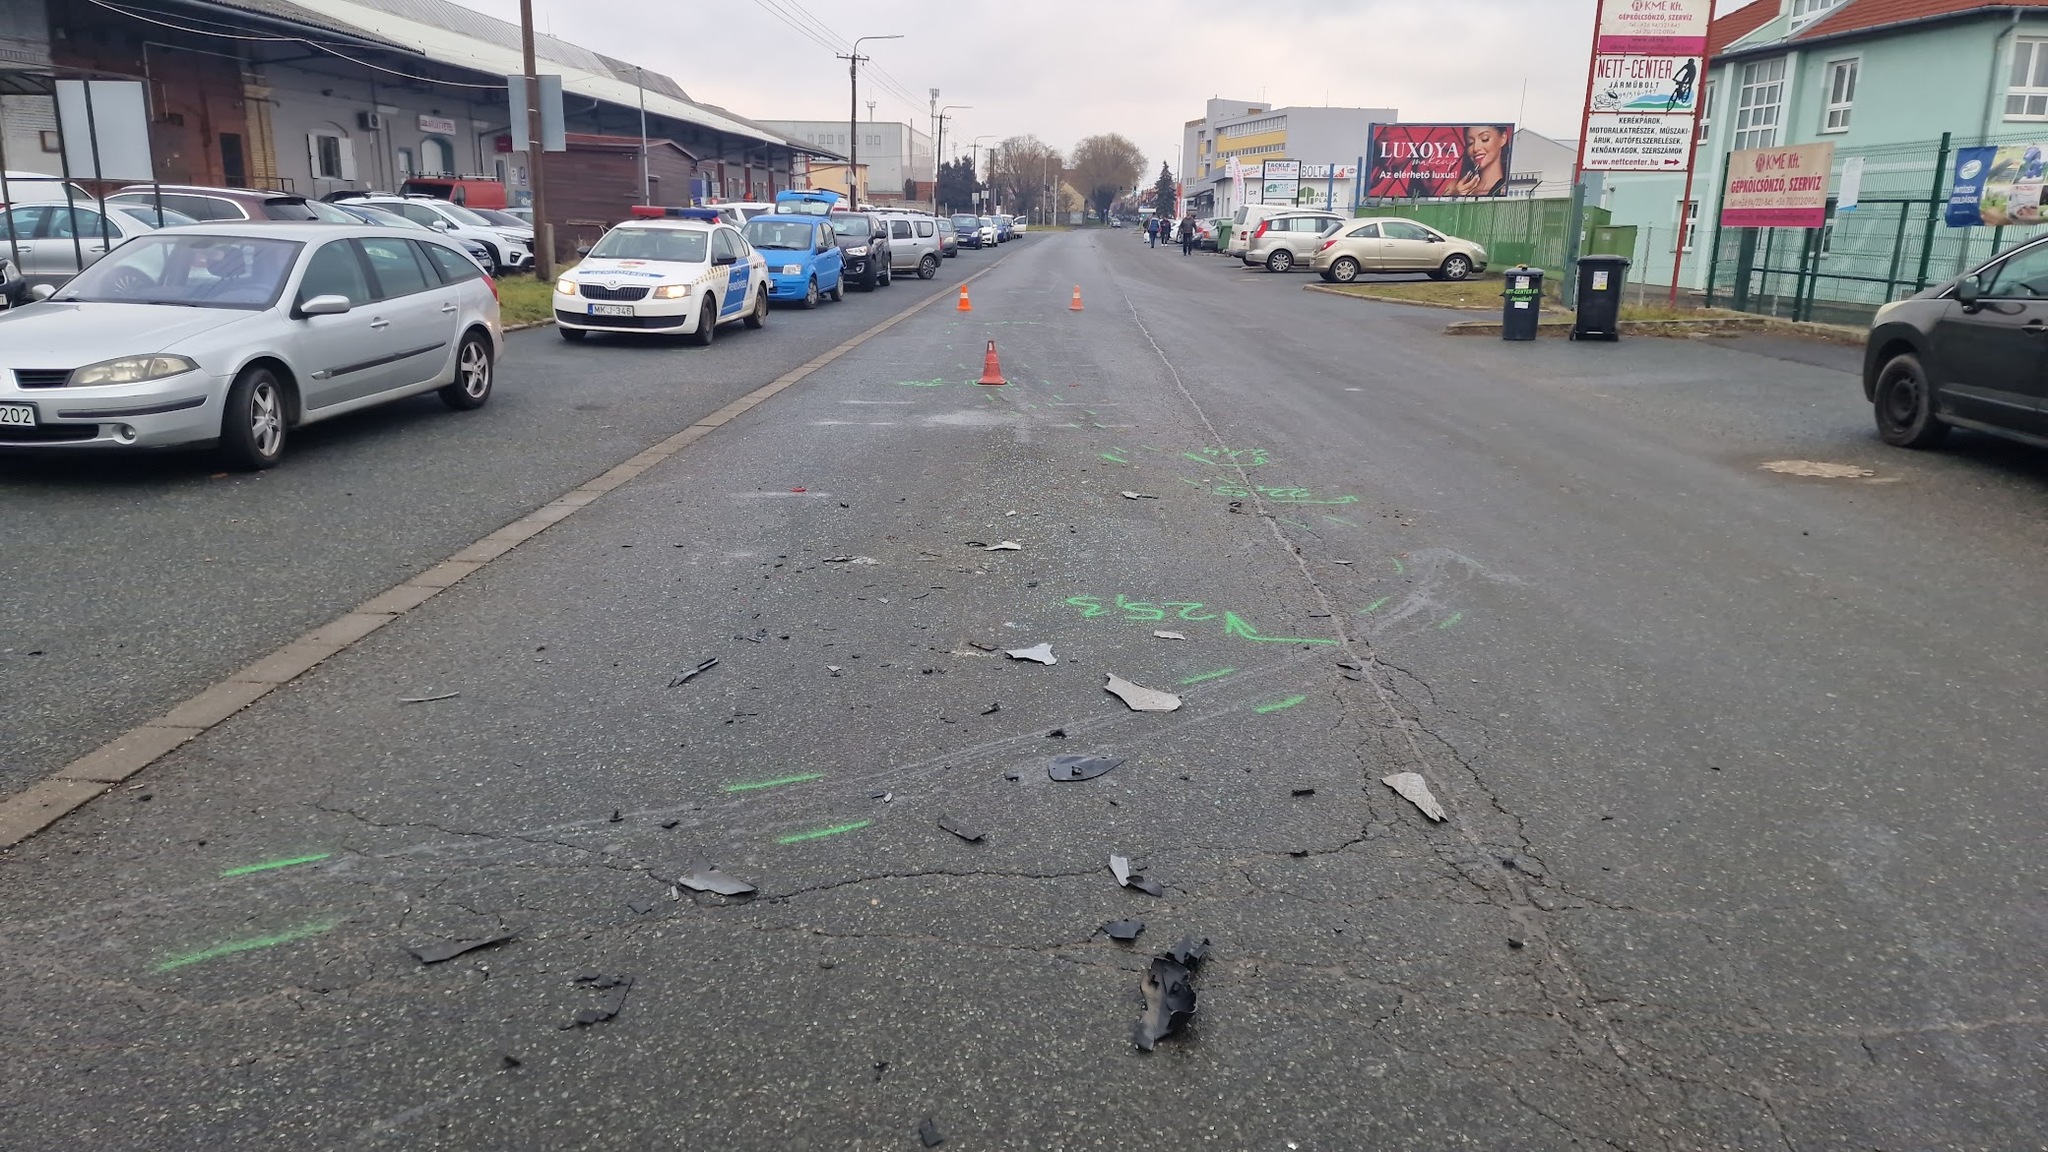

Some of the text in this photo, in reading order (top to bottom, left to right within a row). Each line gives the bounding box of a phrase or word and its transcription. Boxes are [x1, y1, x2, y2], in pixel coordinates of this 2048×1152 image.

[1644, 0, 1683, 11] KME Kft.
[1597, 59, 1673, 79] NETT-CENTER
[1609, 80, 1660, 89] JÁRMŰBOLT
[1619, 115, 1663, 125] KERÉKPÁROK,
[1589, 126, 1690, 135] MOTORALKATRÉSZEK, MŰSZAKI-
[1593, 136, 1683, 145] ÁRUK, AUTÓFELSZERELÉSEK,
[1380, 141, 1460, 159] LUXOYA
[1591, 146, 1683, 155] KENŐANYAGOK, SZERSZÁMOK
[1412, 151, 1458, 172] makeup
[1591, 158, 1659, 166] www.nettcenter.hu
[1765, 152, 1800, 170] KME Kft.
[1379, 169, 1458, 179] Az elérhető luxus!
[594, 306, 632, 315] MKJ-346
